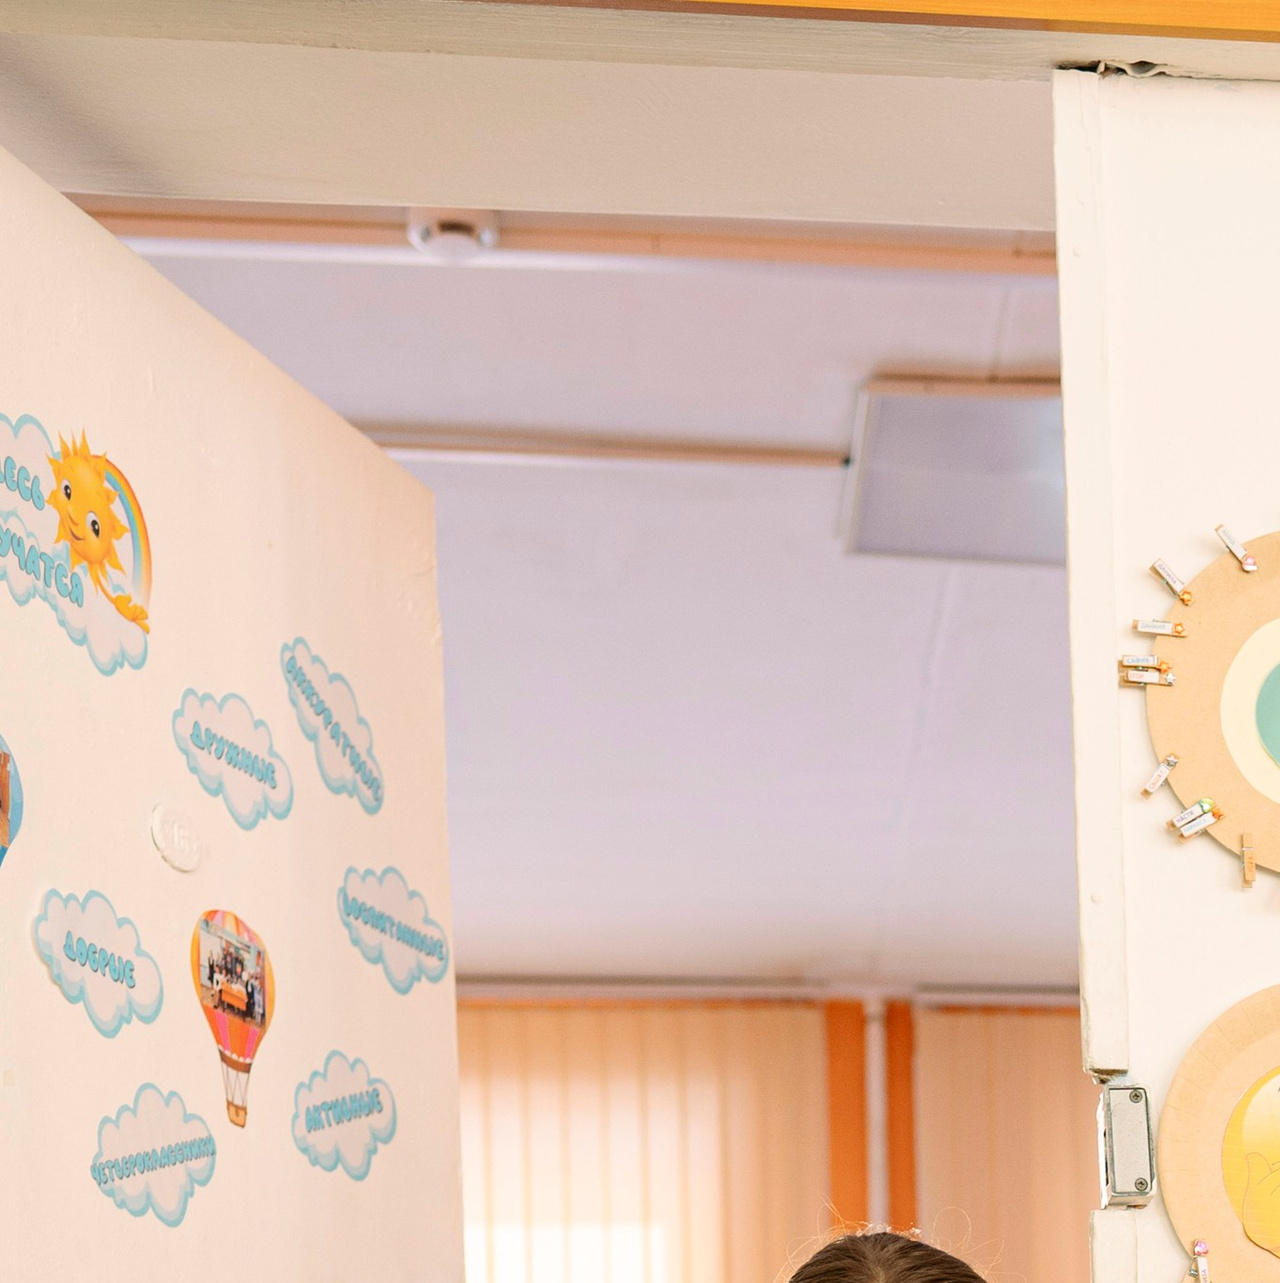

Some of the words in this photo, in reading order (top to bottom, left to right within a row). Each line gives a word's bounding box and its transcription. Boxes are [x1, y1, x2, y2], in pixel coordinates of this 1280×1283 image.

[0, 456, 45, 511] ЕСЬ
[190, 720, 277, 790] ДРУЖНЫЕ
[343, 891, 444, 961] ВОСПИТАННЫЕ
[63, 931, 136, 989] ДОБРЫЕ
[305, 1087, 383, 1134] АКТИВНЫЕ
[90, 1135, 217, 1186] ЧЕТВЕРОКЛАССНИКИ
